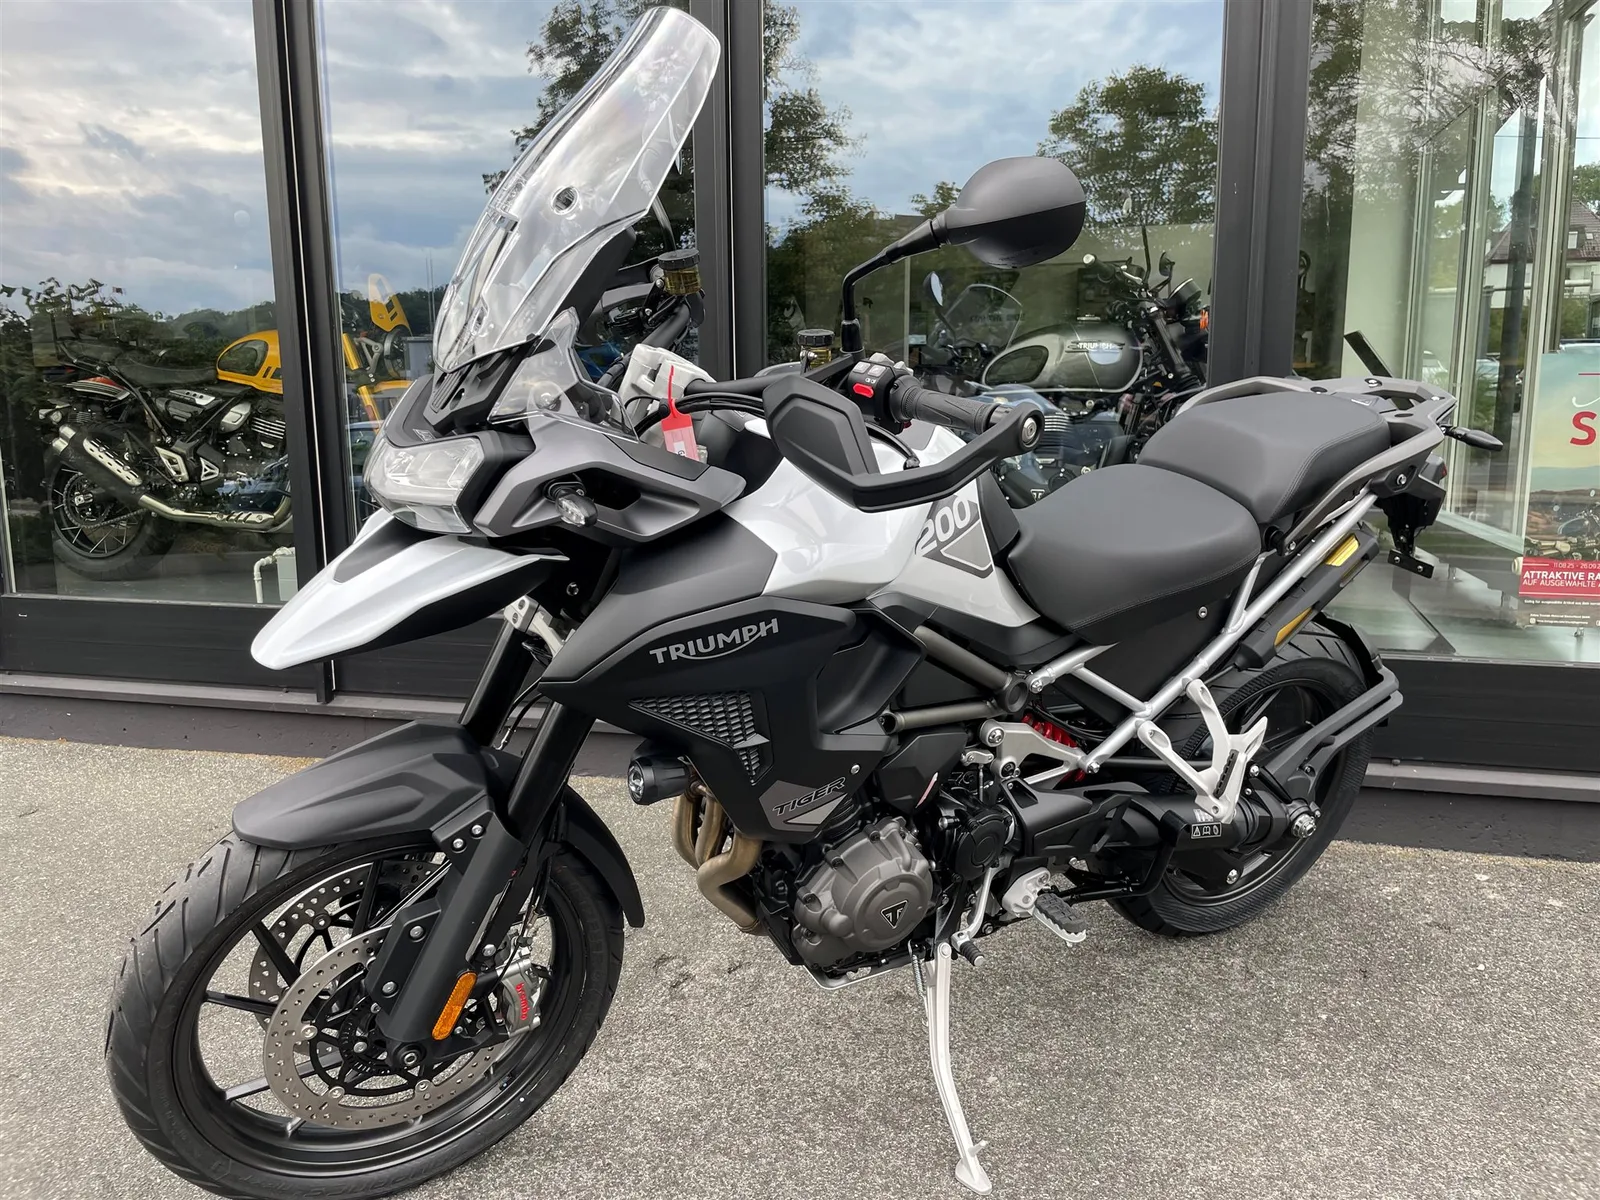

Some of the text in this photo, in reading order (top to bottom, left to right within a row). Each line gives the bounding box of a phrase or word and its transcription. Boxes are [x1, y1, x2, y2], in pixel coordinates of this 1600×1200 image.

[1523, 571, 1585, 580] ATTRAKTIVE
[649, 618, 779, 664] TRIUMPH
[772, 776, 846, 816] TIGER
[515, 982, 531, 1021] brembo
